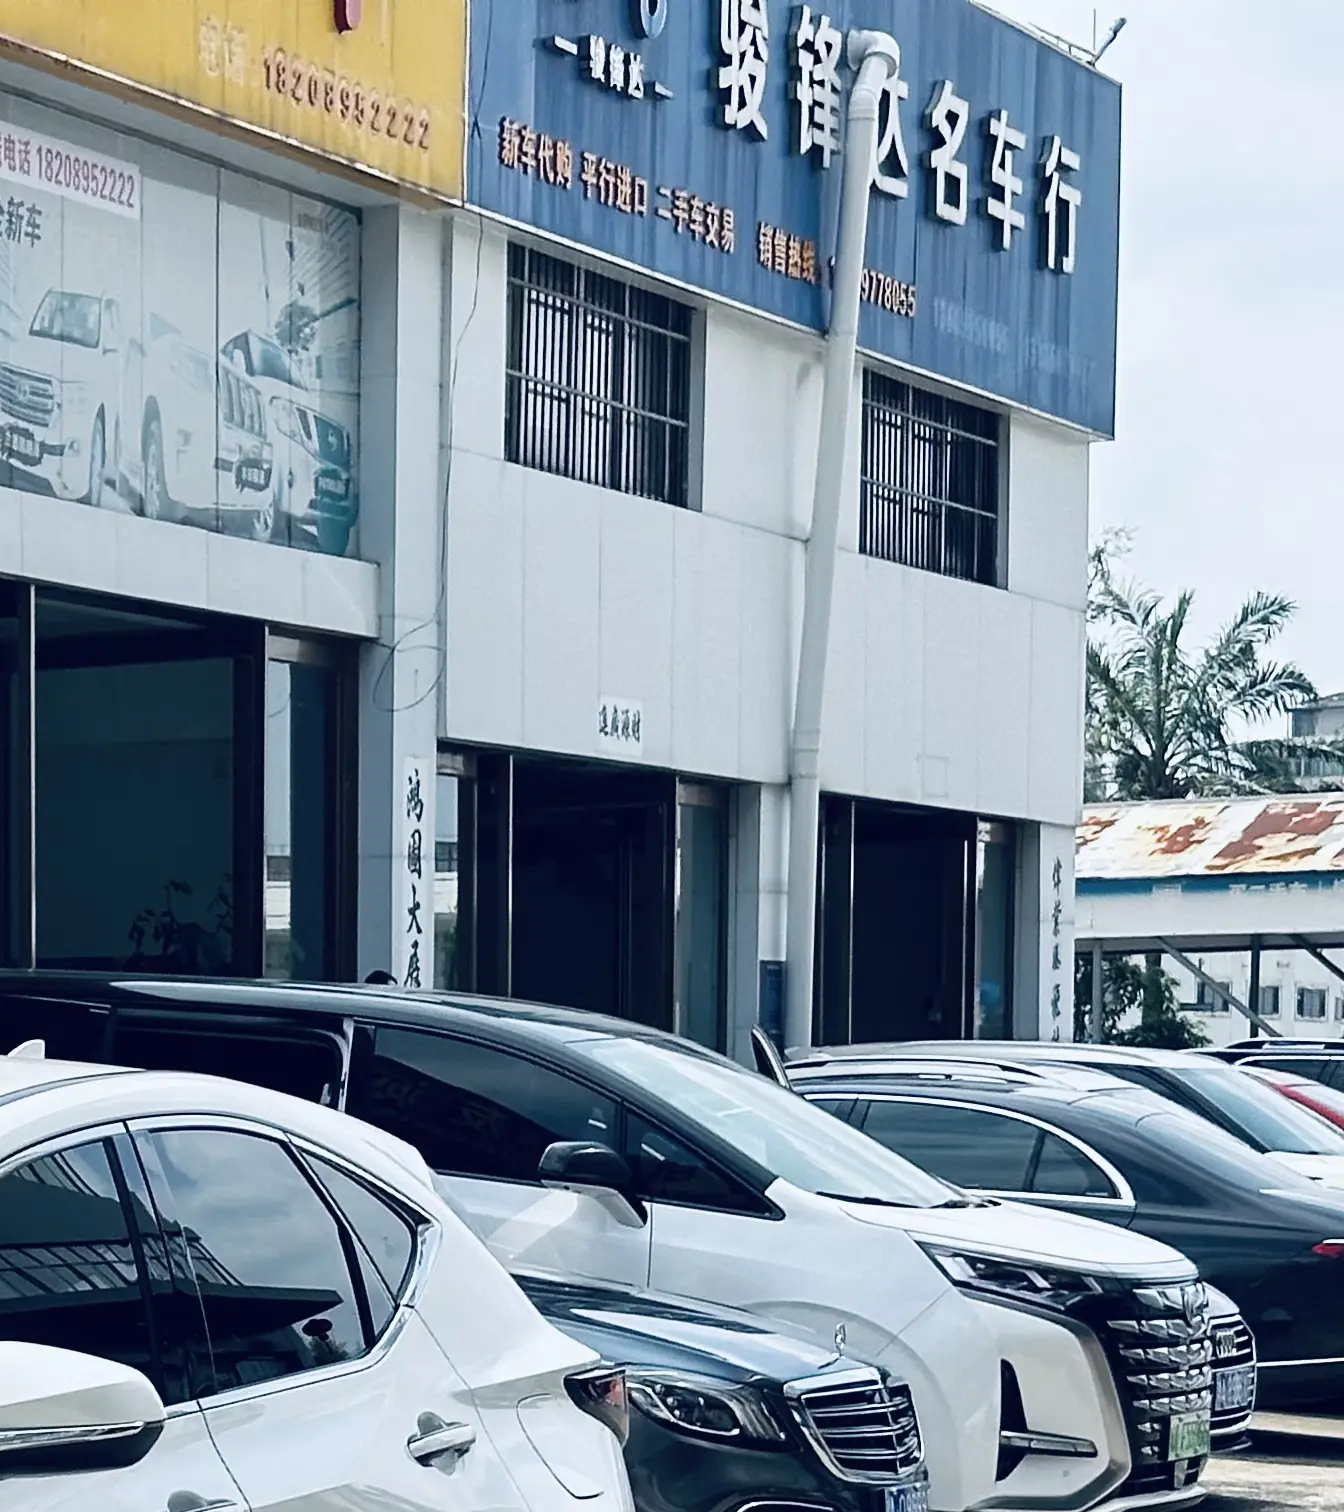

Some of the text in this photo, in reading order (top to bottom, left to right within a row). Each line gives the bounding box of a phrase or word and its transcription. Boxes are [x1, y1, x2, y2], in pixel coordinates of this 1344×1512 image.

[36, 144, 136, 209] 18208952222
[500, 117, 573, 190] 新车代购
[582, 152, 648, 216] 平行进口
[656, 186, 735, 254] 二手车交易
